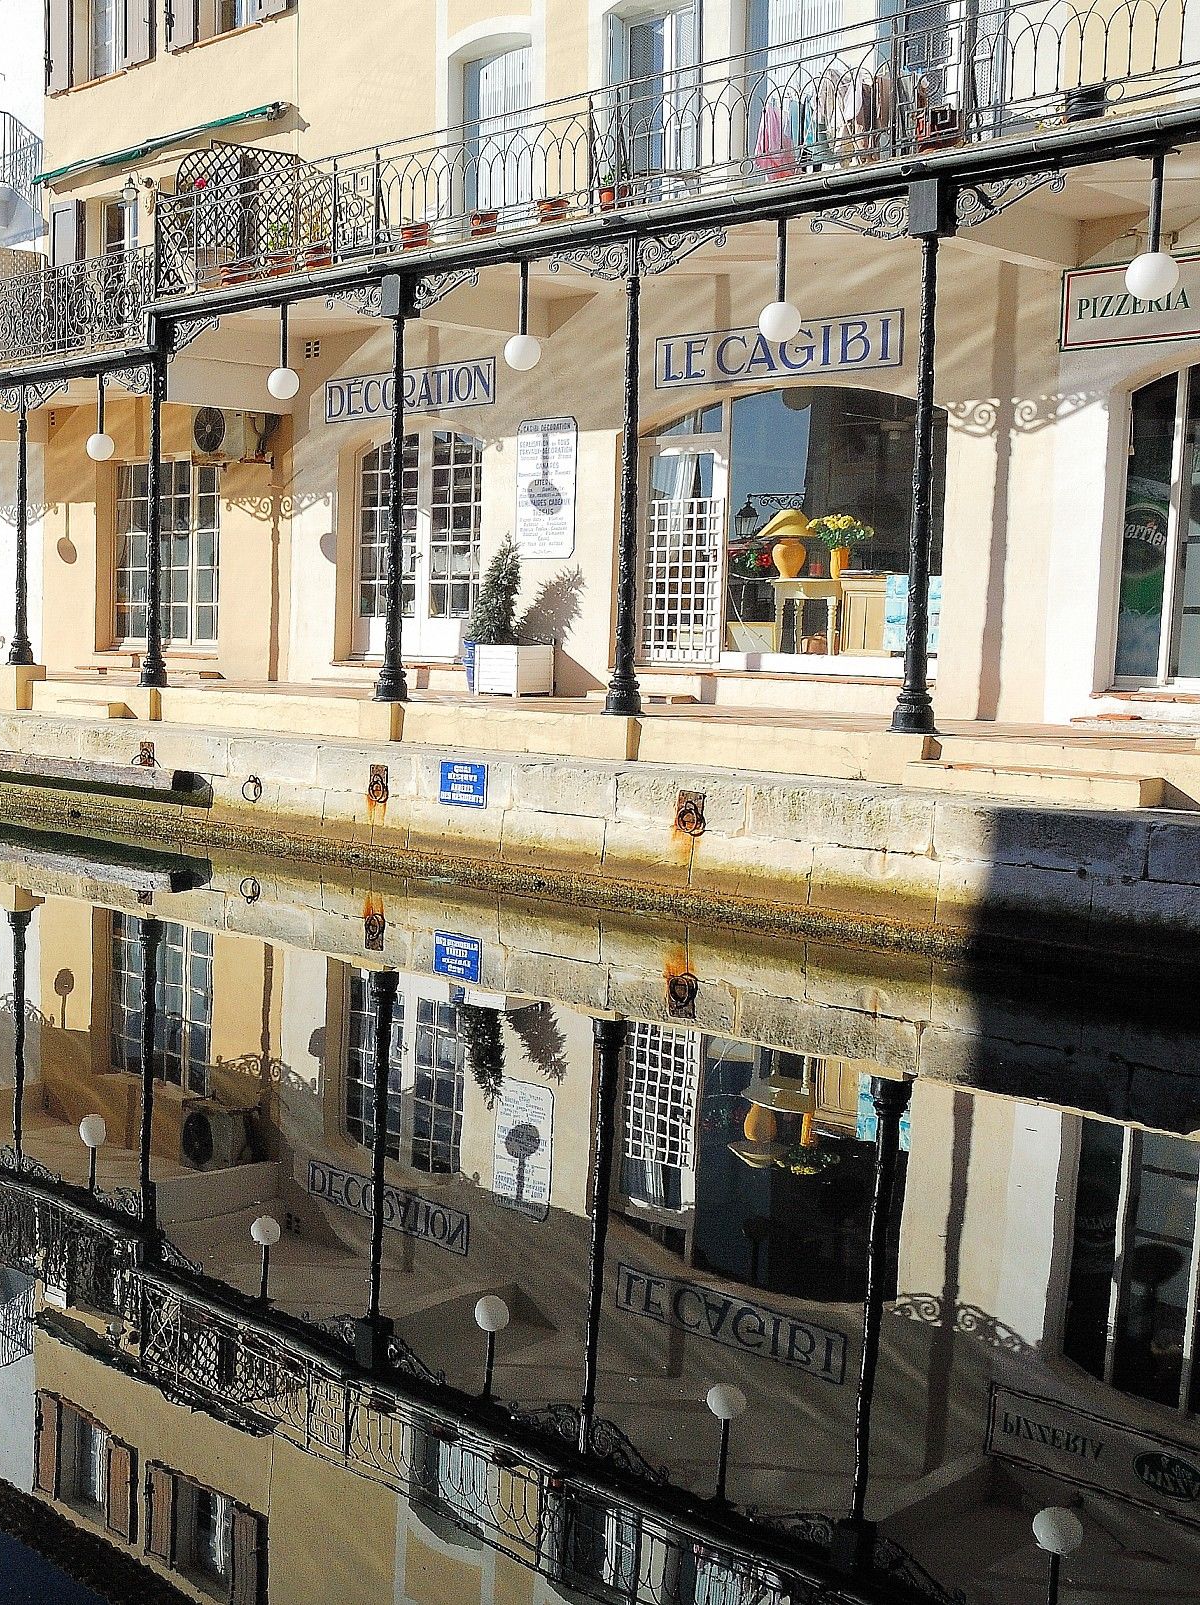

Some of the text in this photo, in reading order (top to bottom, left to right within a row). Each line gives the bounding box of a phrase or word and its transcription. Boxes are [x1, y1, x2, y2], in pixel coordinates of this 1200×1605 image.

[1076, 287, 1191, 320] PIZZERIA
[662, 318, 892, 382] LE CAGIBI
[1124, 522, 1167, 547] errier
